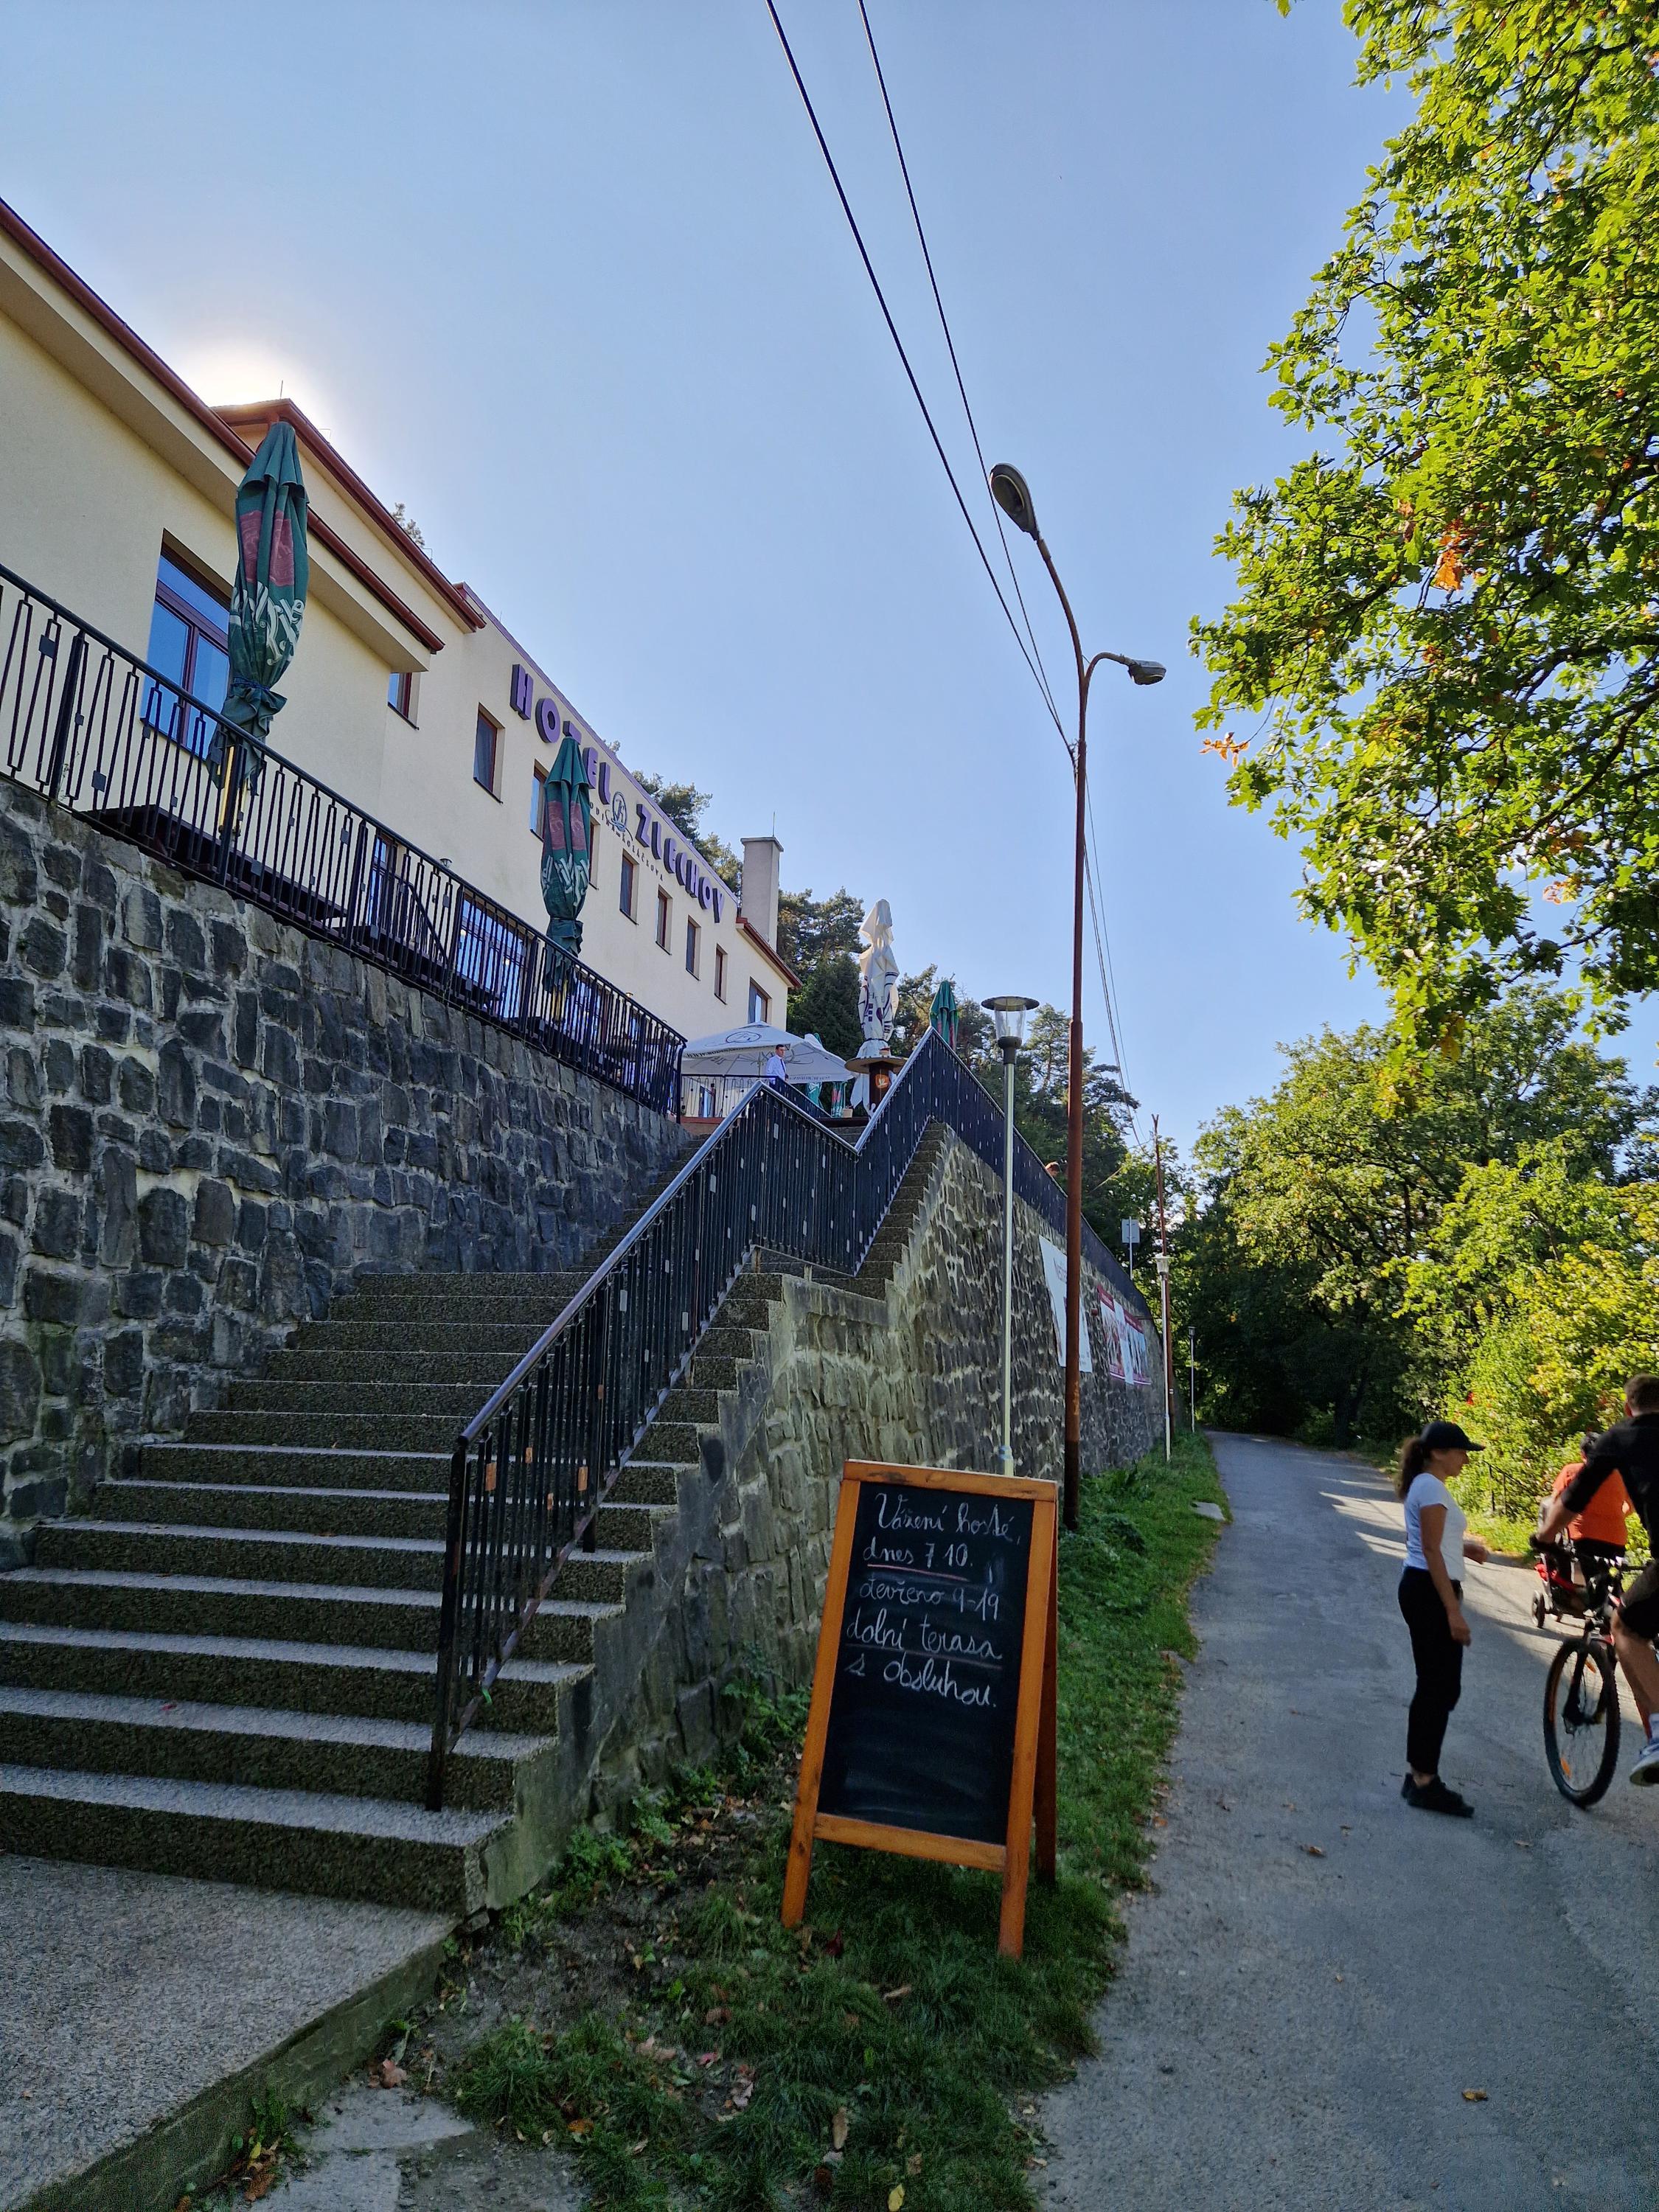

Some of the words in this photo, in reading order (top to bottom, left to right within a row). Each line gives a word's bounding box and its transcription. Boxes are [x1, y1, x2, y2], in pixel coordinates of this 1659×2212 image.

[863, 1536, 914, 1565] dnes
[846, 1607, 908, 1650] dolní
[920, 1614, 1003, 1660] terasa
